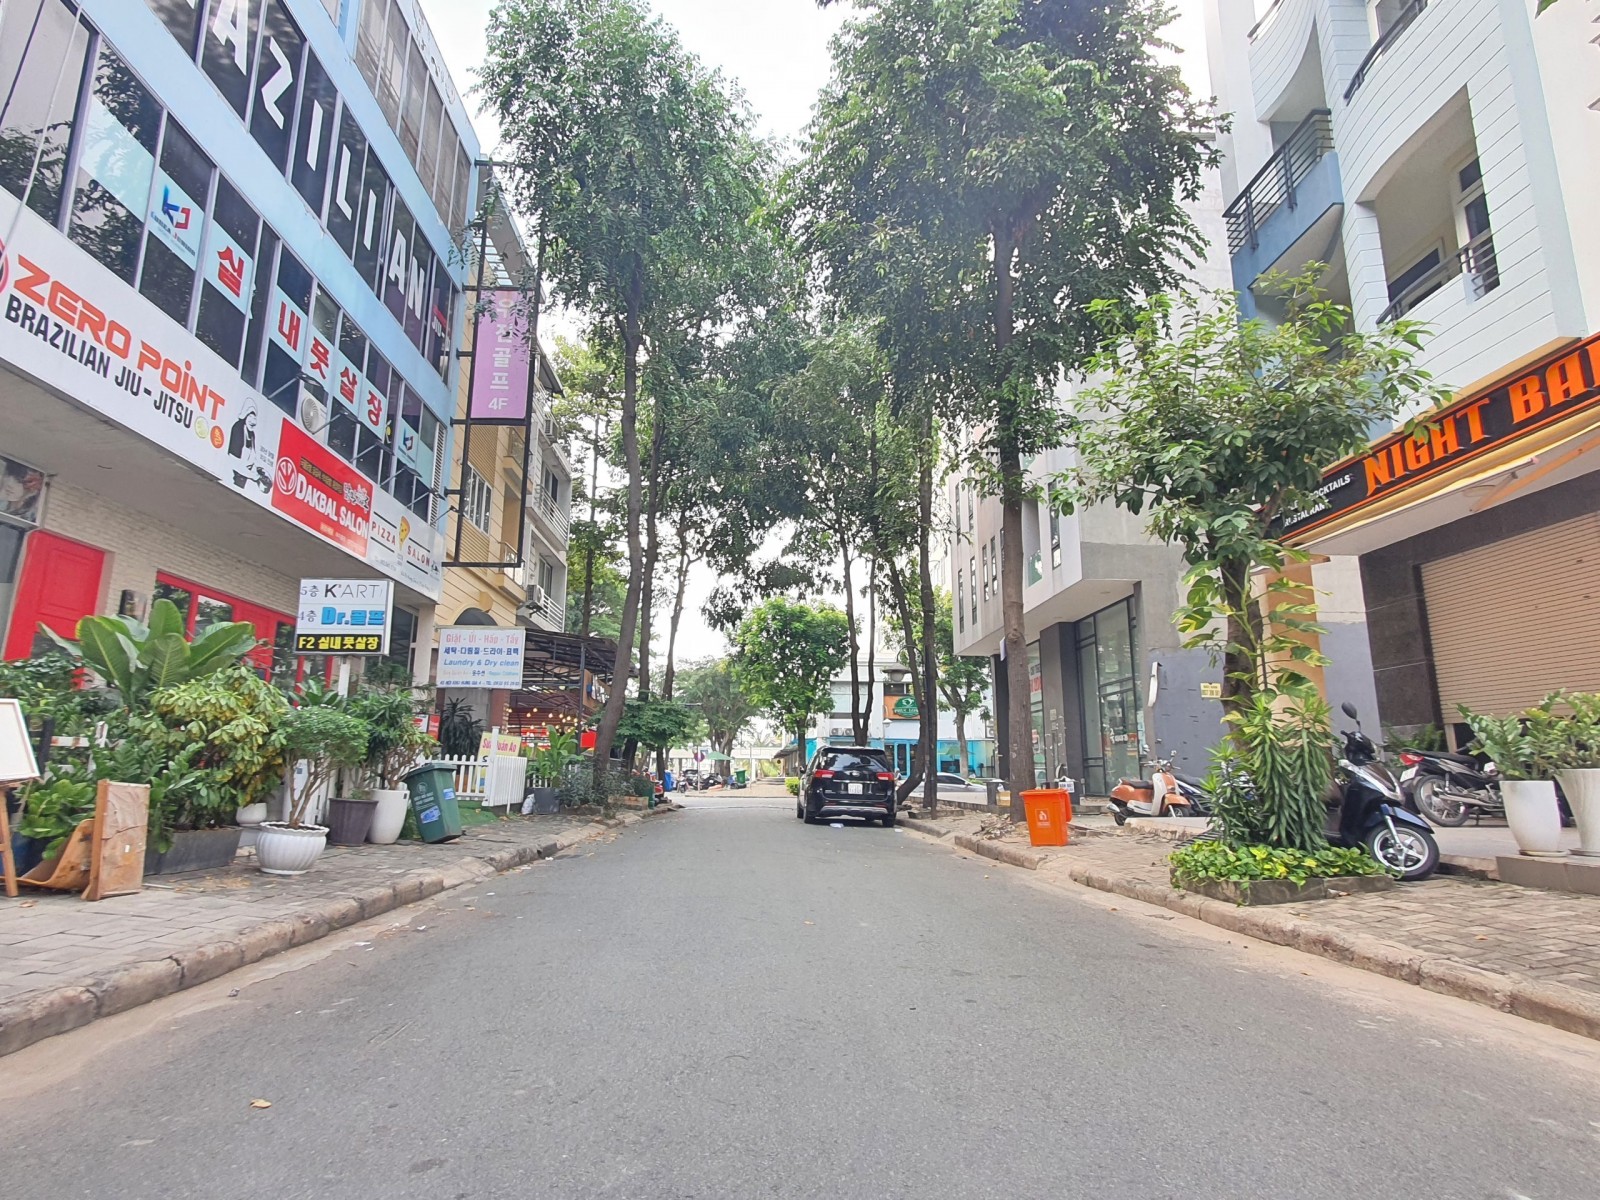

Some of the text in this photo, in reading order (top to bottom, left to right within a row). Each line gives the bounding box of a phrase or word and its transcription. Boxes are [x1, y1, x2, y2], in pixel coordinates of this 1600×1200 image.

[13, 254, 131, 360] ZERO
[5, 294, 111, 379] BRAZILIAN
[488, 397, 509, 411] 4F
[1363, 397, 1490, 498] NIGHT
[297, 473, 338, 522] DAKBAL
[340, 506, 369, 540] SALON
[371, 520, 396, 546] PIZZA
[407, 545, 431, 567] SALON
[300, 585, 320, 597] 5층
[298, 636, 315, 649] F2
[443, 658, 475, 668] Laundry
[484, 658, 498, 668] Dry
[499, 658, 520, 667] clean
